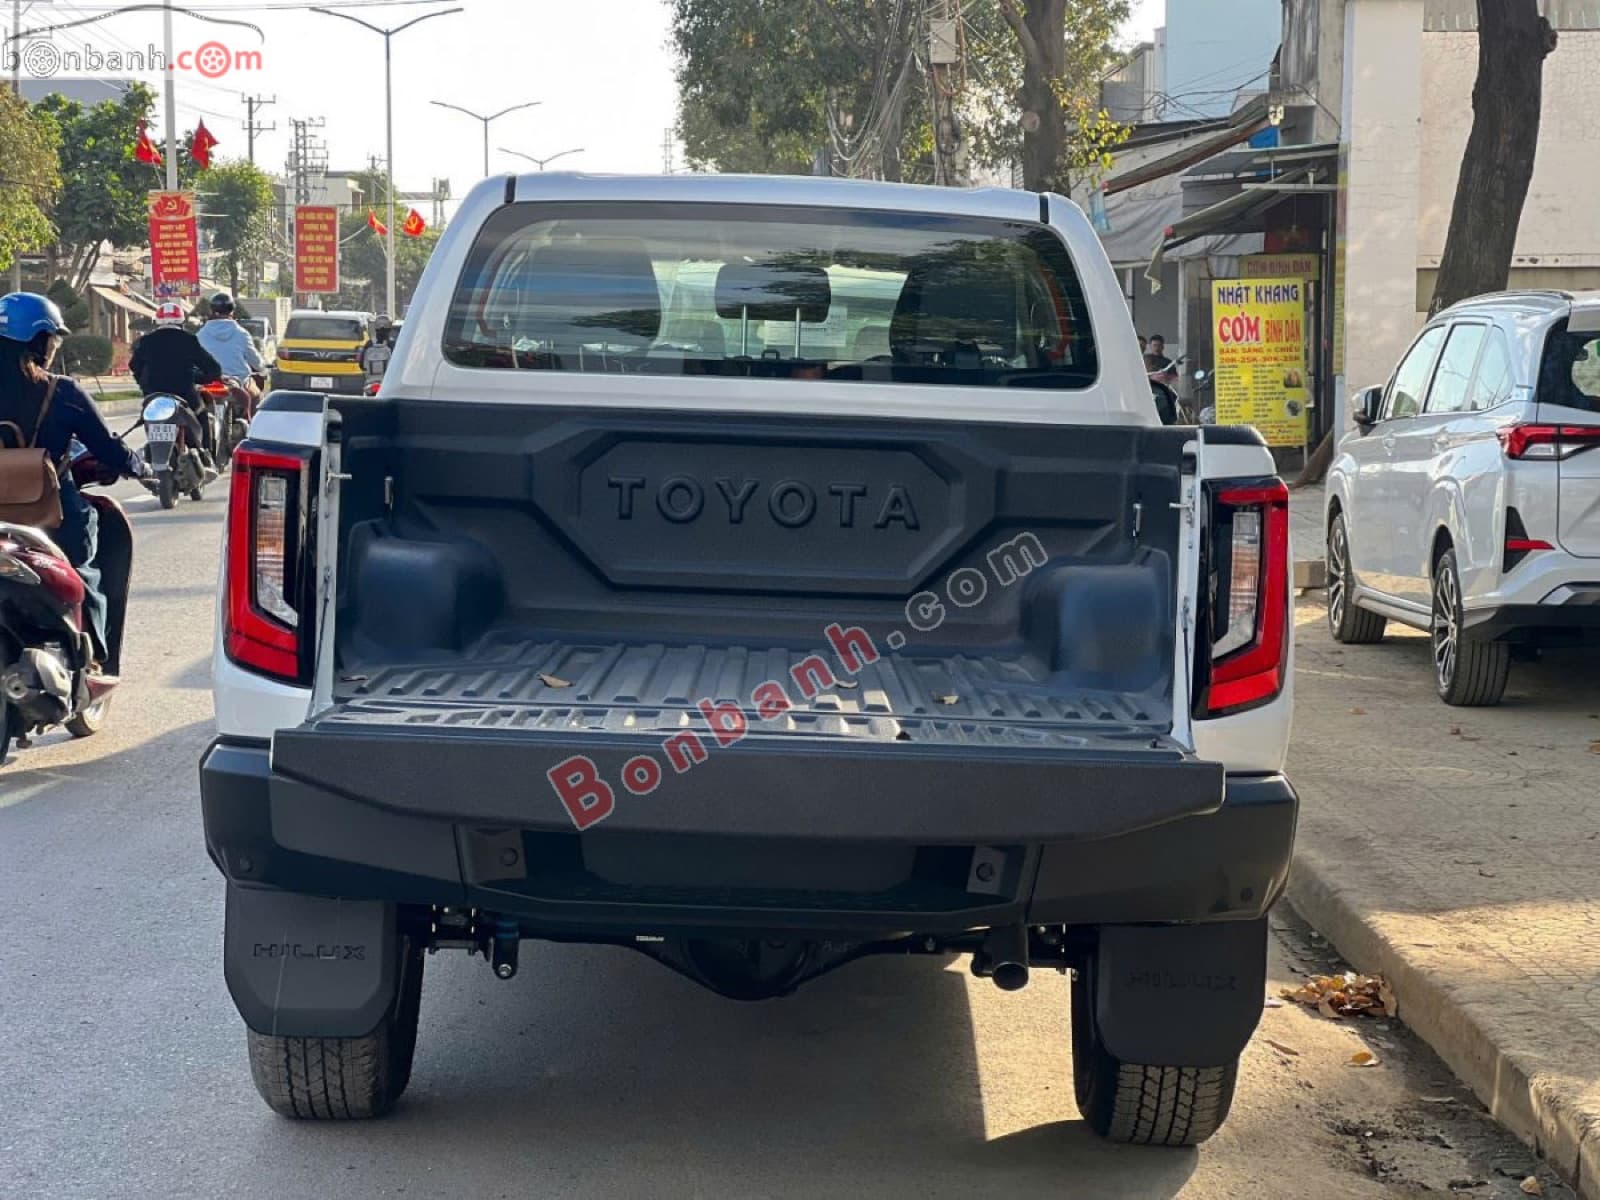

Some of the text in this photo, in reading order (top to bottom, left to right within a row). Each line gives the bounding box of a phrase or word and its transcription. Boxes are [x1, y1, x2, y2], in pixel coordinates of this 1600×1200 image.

[1218, 282, 1298, 308] NHẬT KHANG
[1218, 311, 1260, 343] CƠM
[607, 475, 920, 531] TOYOTA
[253, 943, 366, 961] HILUX
